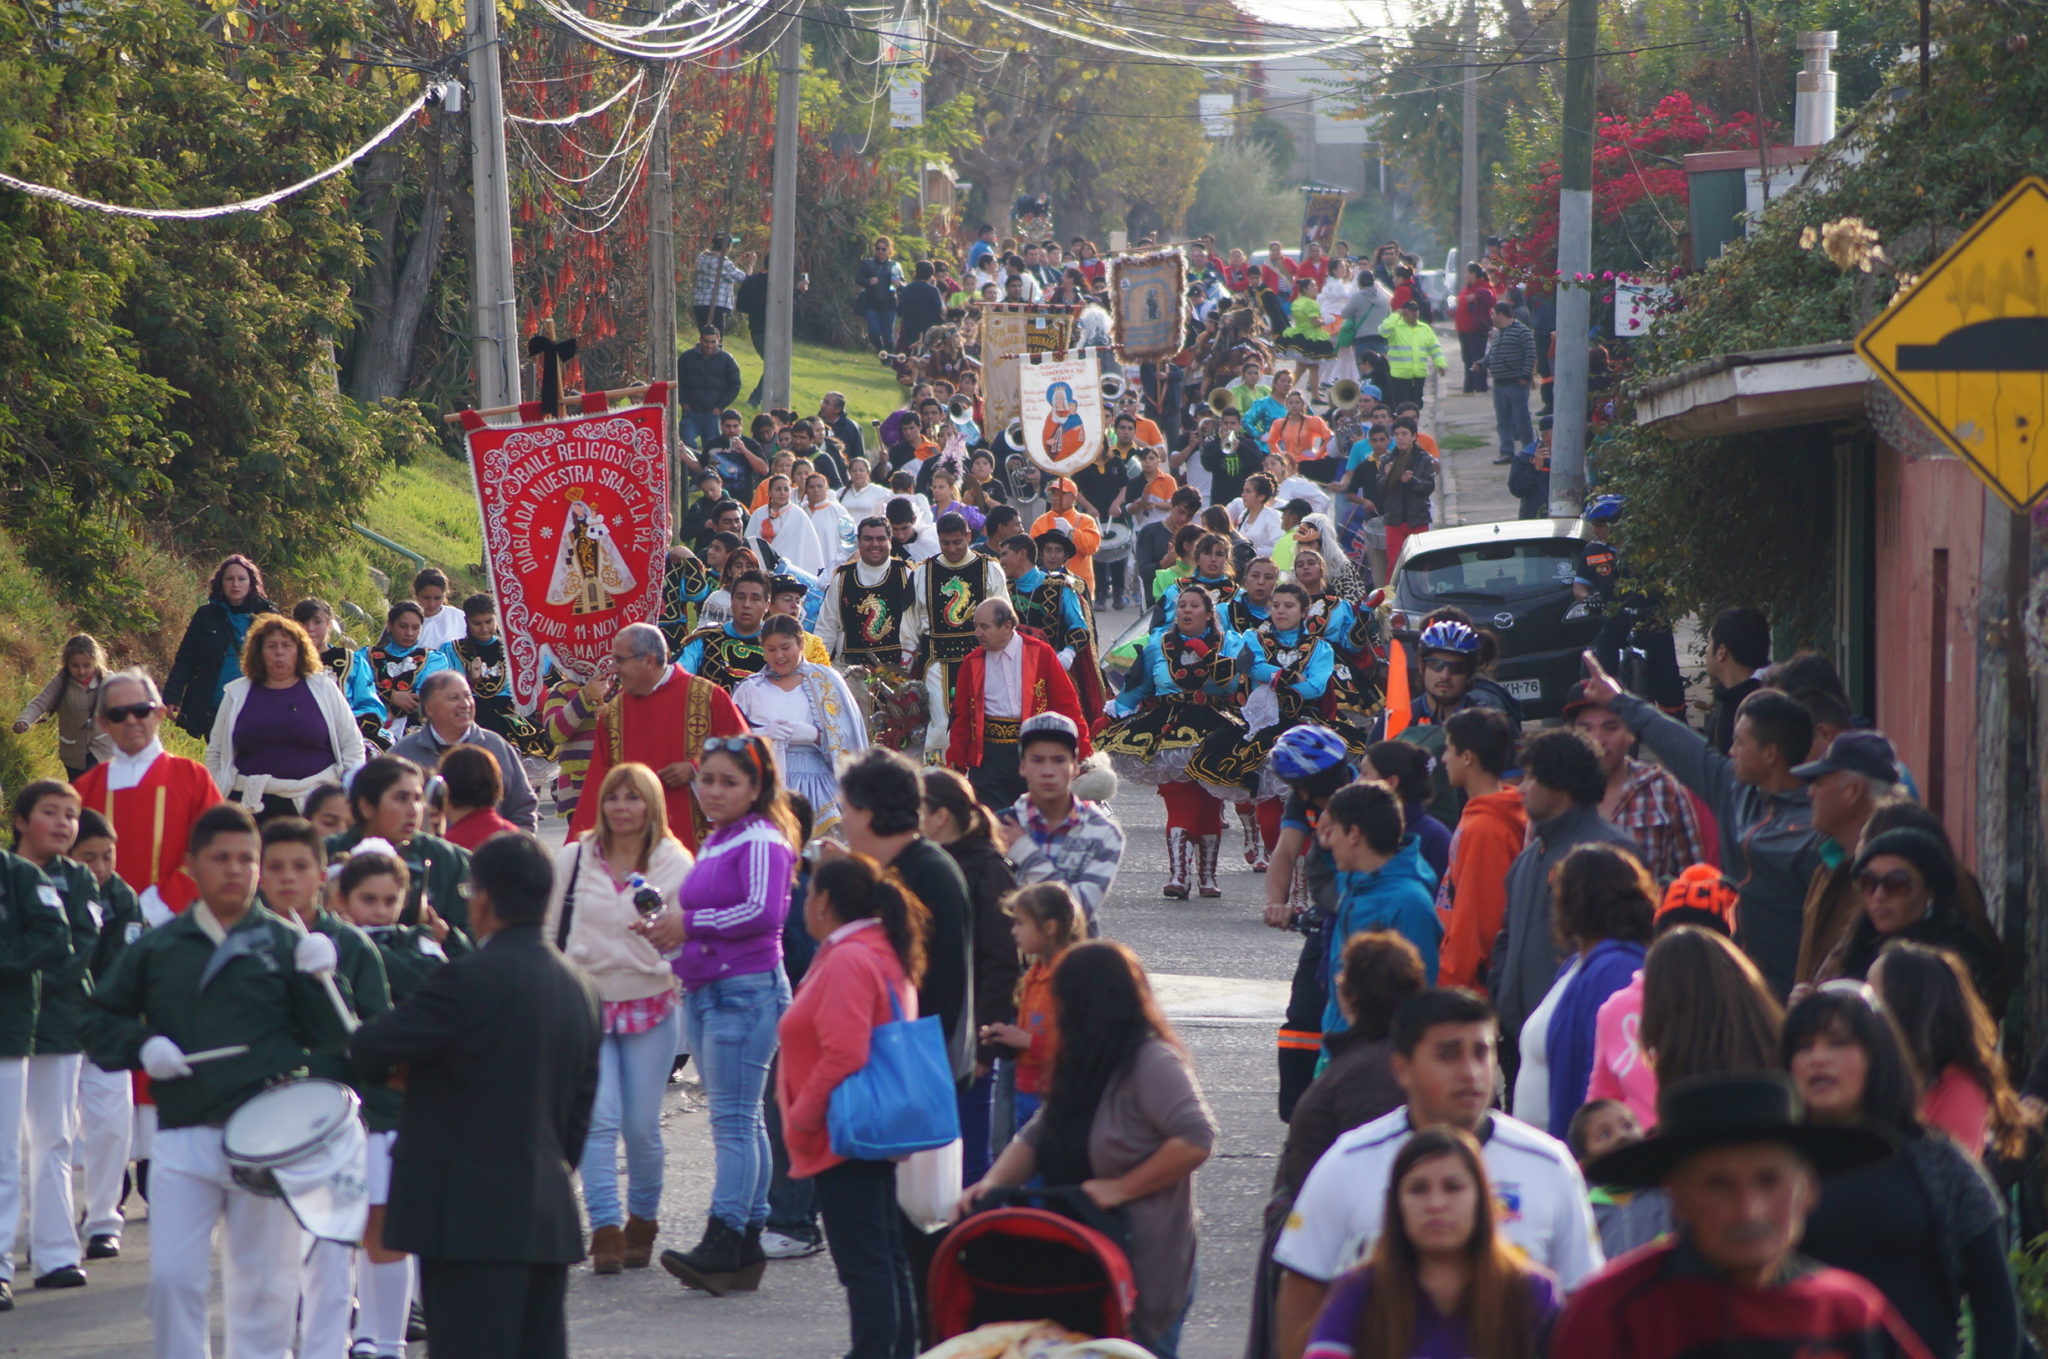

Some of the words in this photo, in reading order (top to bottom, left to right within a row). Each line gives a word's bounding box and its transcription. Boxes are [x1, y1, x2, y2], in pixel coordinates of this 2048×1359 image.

[513, 449, 556, 484] BAILE
[556, 441, 633, 469] RELIGIOSO
[528, 465, 594, 502] NUESTRA
[620, 483, 642, 506] DE
[629, 503, 649, 524] LA
[511, 500, 539, 574] DIABLADA
[632, 527, 652, 553] PAZ
